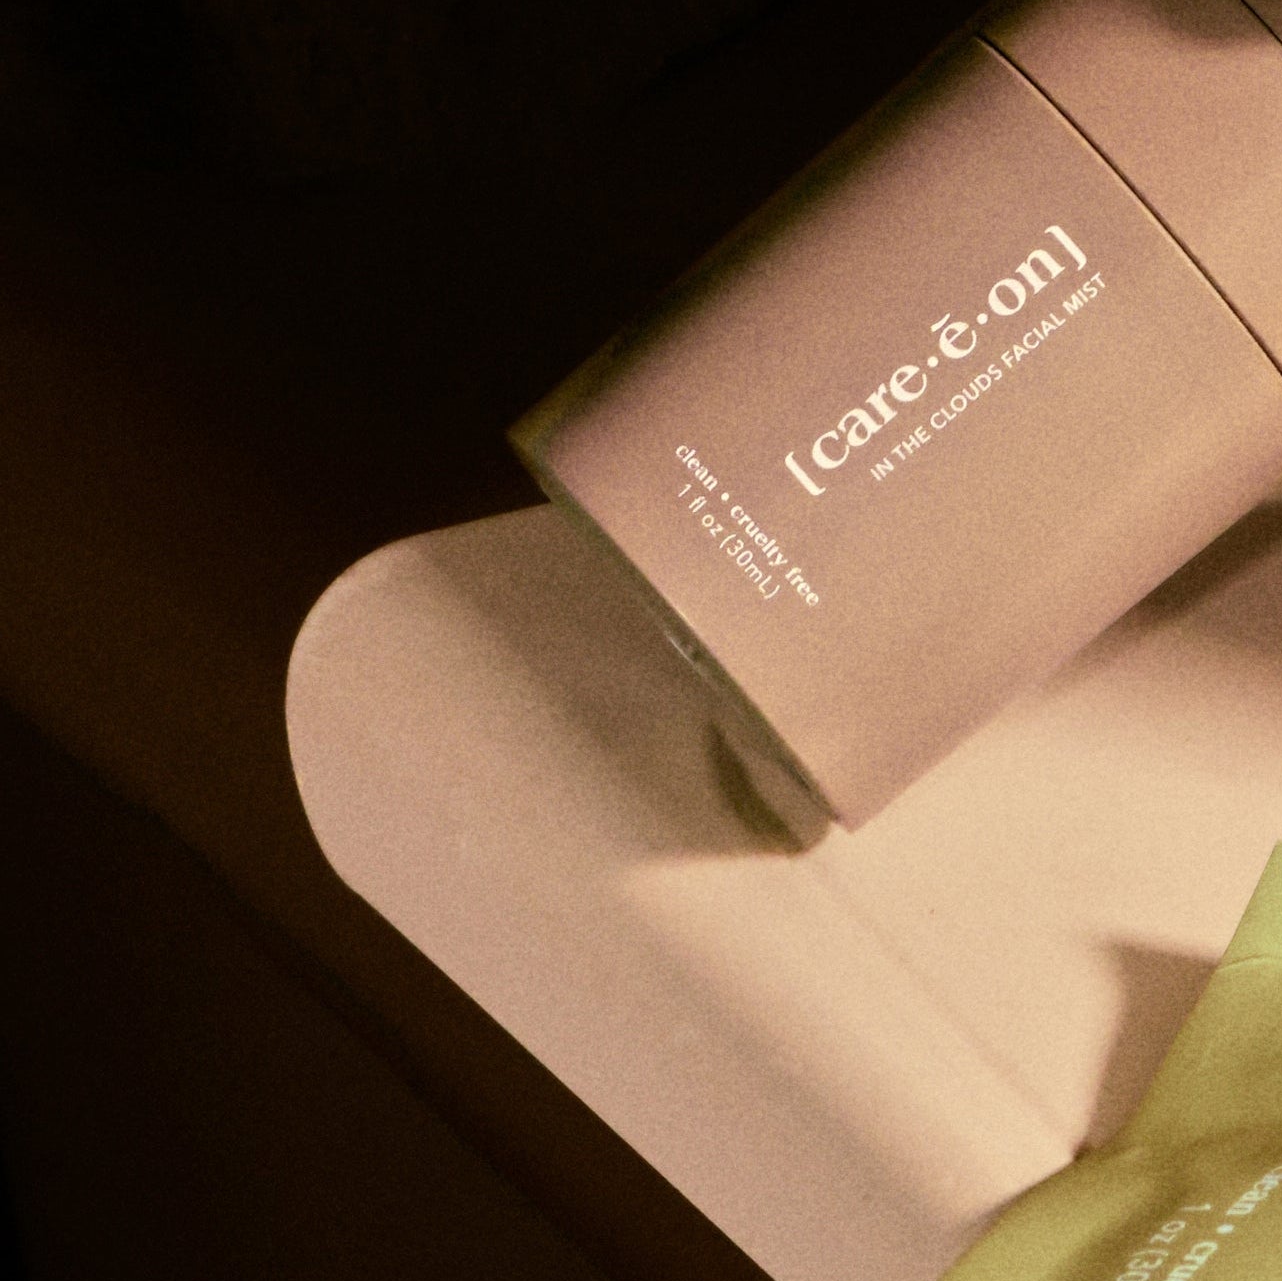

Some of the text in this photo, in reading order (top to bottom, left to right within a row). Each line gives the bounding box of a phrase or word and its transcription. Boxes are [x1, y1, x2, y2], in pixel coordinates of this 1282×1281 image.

[870, 271, 1107, 482] IN THE CLOUDS FACIAL MIST
[674, 444, 719, 492] clean
[729, 505, 789, 567] cruelty
[784, 566, 821, 606] free
[677, 483, 692, 498] 1
[701, 513, 723, 538] oz
[719, 533, 782, 600] (30mL)
